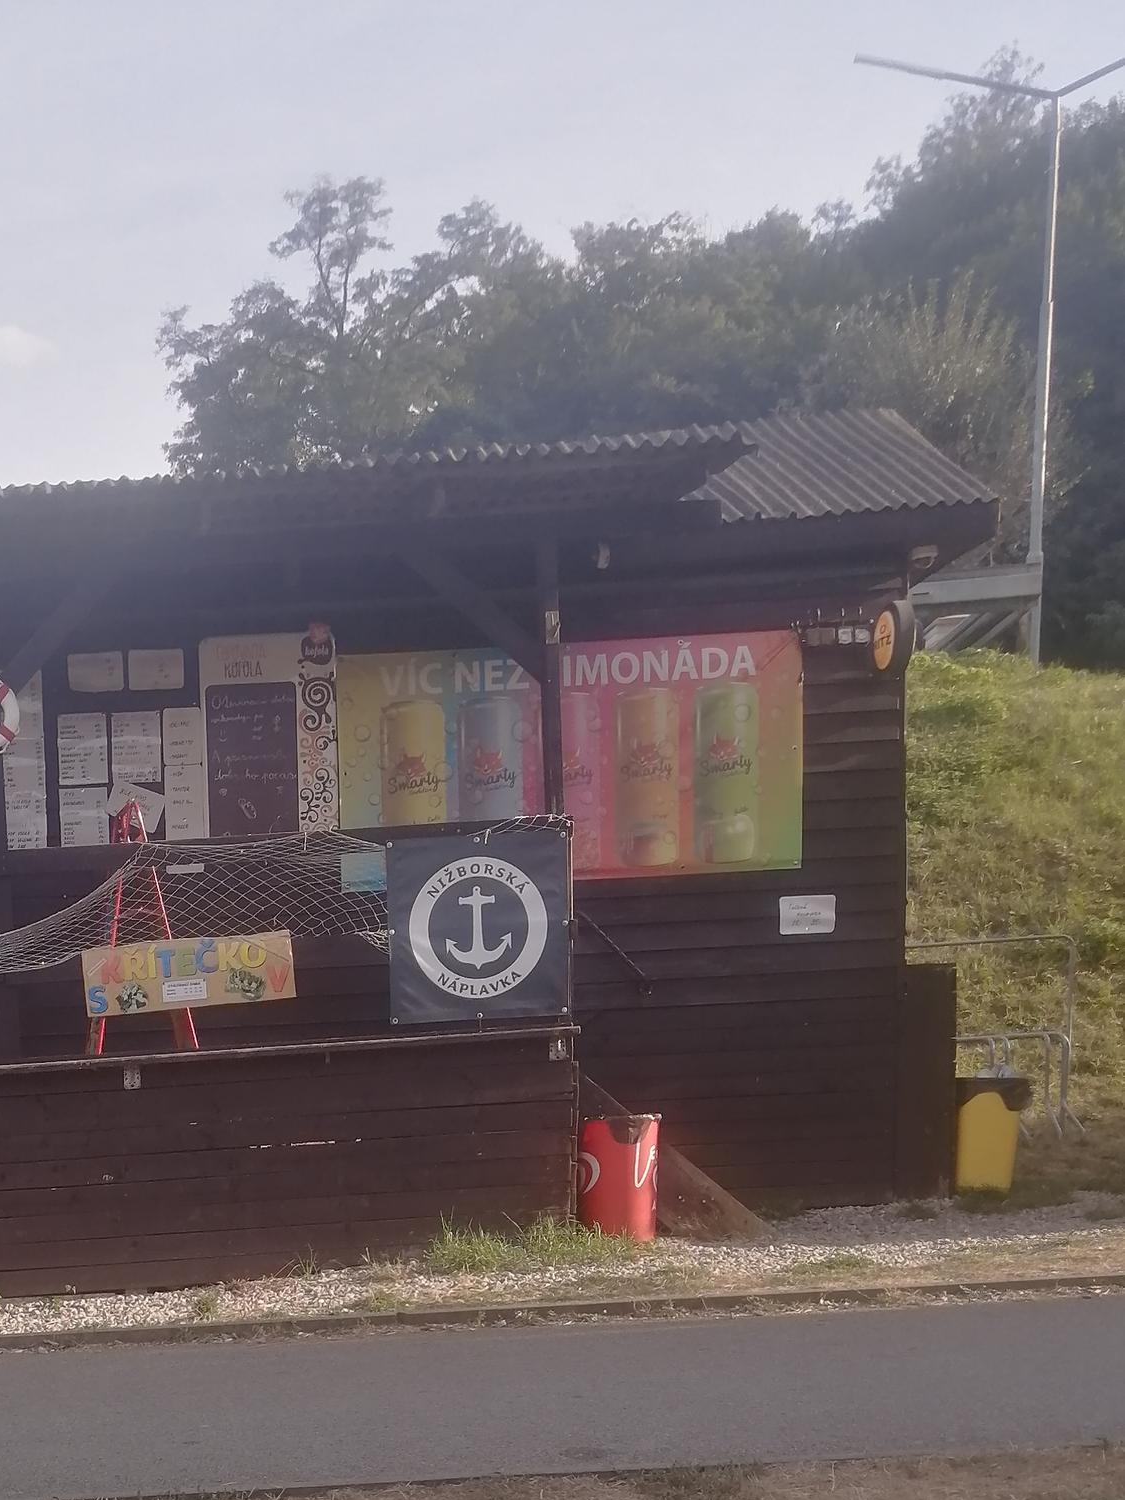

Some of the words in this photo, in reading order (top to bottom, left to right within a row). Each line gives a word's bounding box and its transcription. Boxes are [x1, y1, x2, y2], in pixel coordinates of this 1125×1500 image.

[224, 661, 263, 680] KOFOLA
[379, 657, 444, 697] VÍC
[562, 641, 757, 688] IMONÁDA
[620, 759, 674, 783] Smarty
[698, 754, 753, 779] Smarty
[387, 770, 440, 795] Smarty
[465, 768, 517, 792] Smarty
[426, 863, 531, 899] NIŽBORSKÁ
[437, 971, 523, 996] NÁPLAVKA
